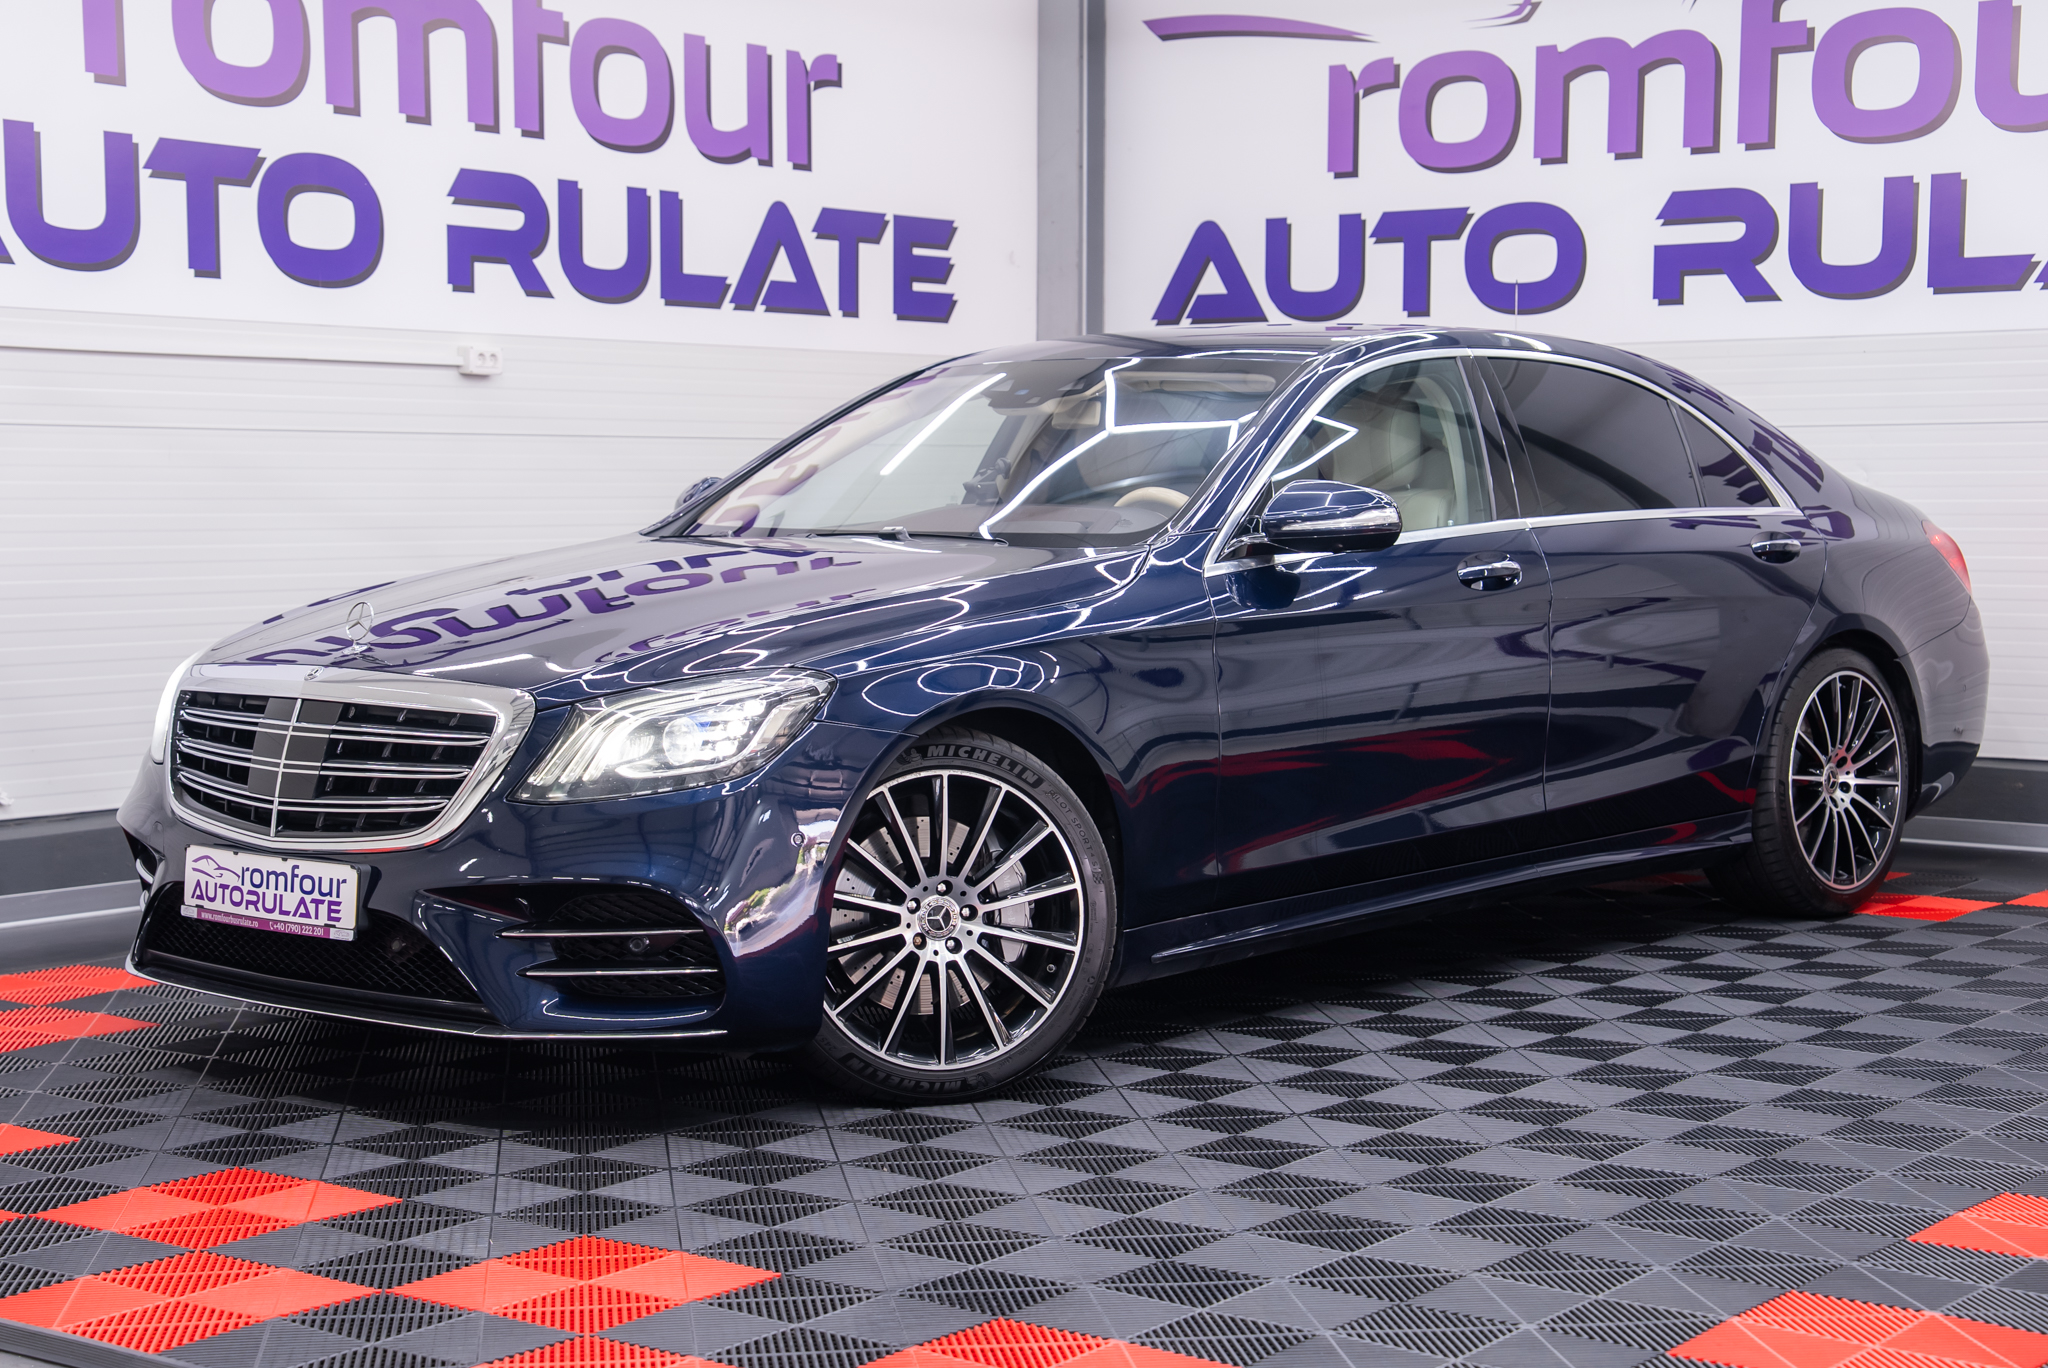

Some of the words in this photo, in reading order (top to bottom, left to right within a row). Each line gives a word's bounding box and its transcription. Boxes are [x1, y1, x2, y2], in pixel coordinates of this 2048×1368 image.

[0, 118, 384, 289] UTO
[447, 167, 957, 323] RULATE
[1152, 200, 1587, 326] AUTO
[1653, 172, 2048, 304] RUL
[927, 744, 1039, 785] MICHELIN
[1071, 817, 1093, 851] SPORT
[241, 864, 347, 898] romfour
[191, 879, 342, 922] AUTORULATE
[302, 925, 313, 935] 222
[313, 927, 324, 936] 201
[846, 1058, 962, 1093] MICHELIN
